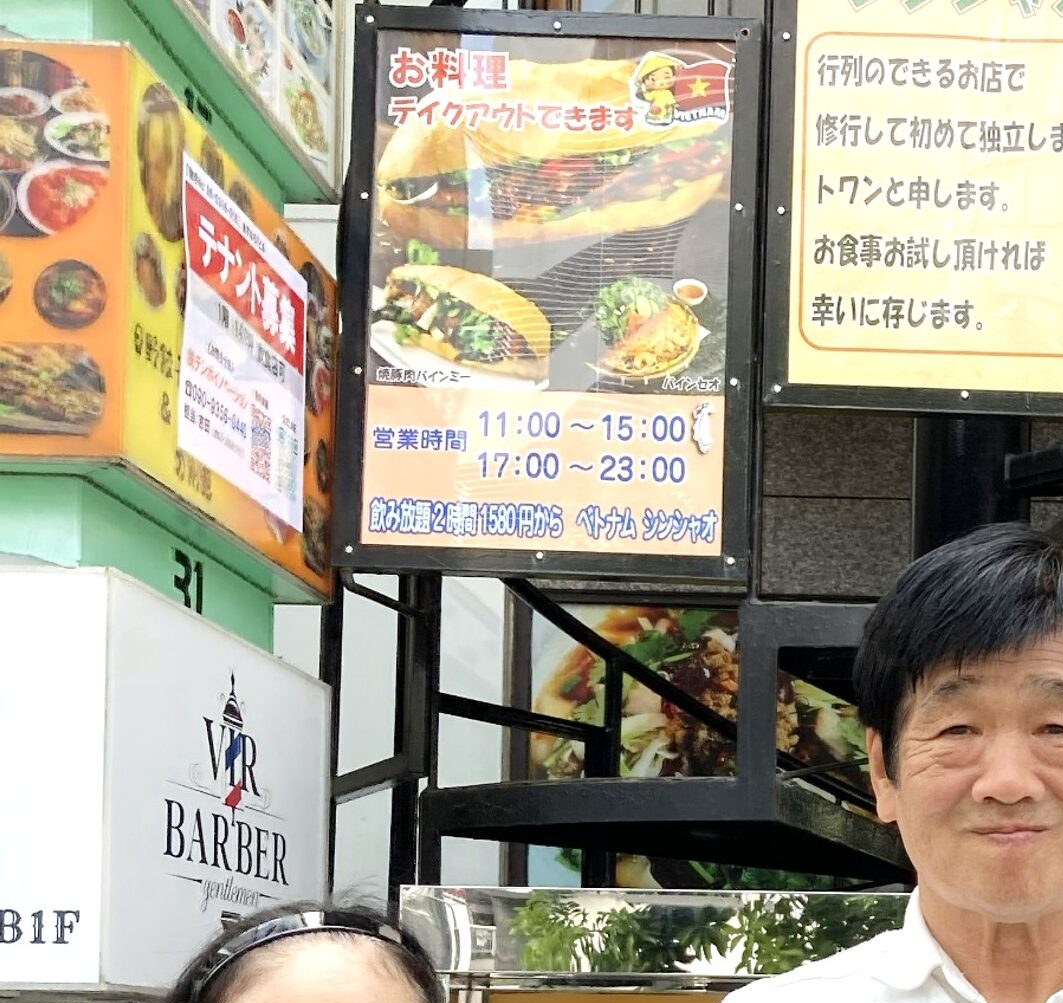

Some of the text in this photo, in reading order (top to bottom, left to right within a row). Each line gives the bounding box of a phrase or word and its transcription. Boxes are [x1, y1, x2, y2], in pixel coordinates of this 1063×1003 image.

[390, 49, 509, 90] お料理
[817, 54, 1026, 93] 行列のできるお店で
[390, 98, 638, 131] テイクアウトできます
[674, 105, 726, 122] VIETNAM
[817, 175, 1008, 212] トワンと申します。
[813, 234, 1046, 271] お食事お試し頂ければ
[199, 214, 296, 356] テナント募集
[811, 294, 984, 331] 幸いに存じます。
[373, 426, 467, 453] 営業時間
[576, 504, 637, 540] ベトナム
[642, 507, 719, 544] シンシャオ
[163, 798, 289, 886] BARBER
[0, 908, 80, 944] B1F
